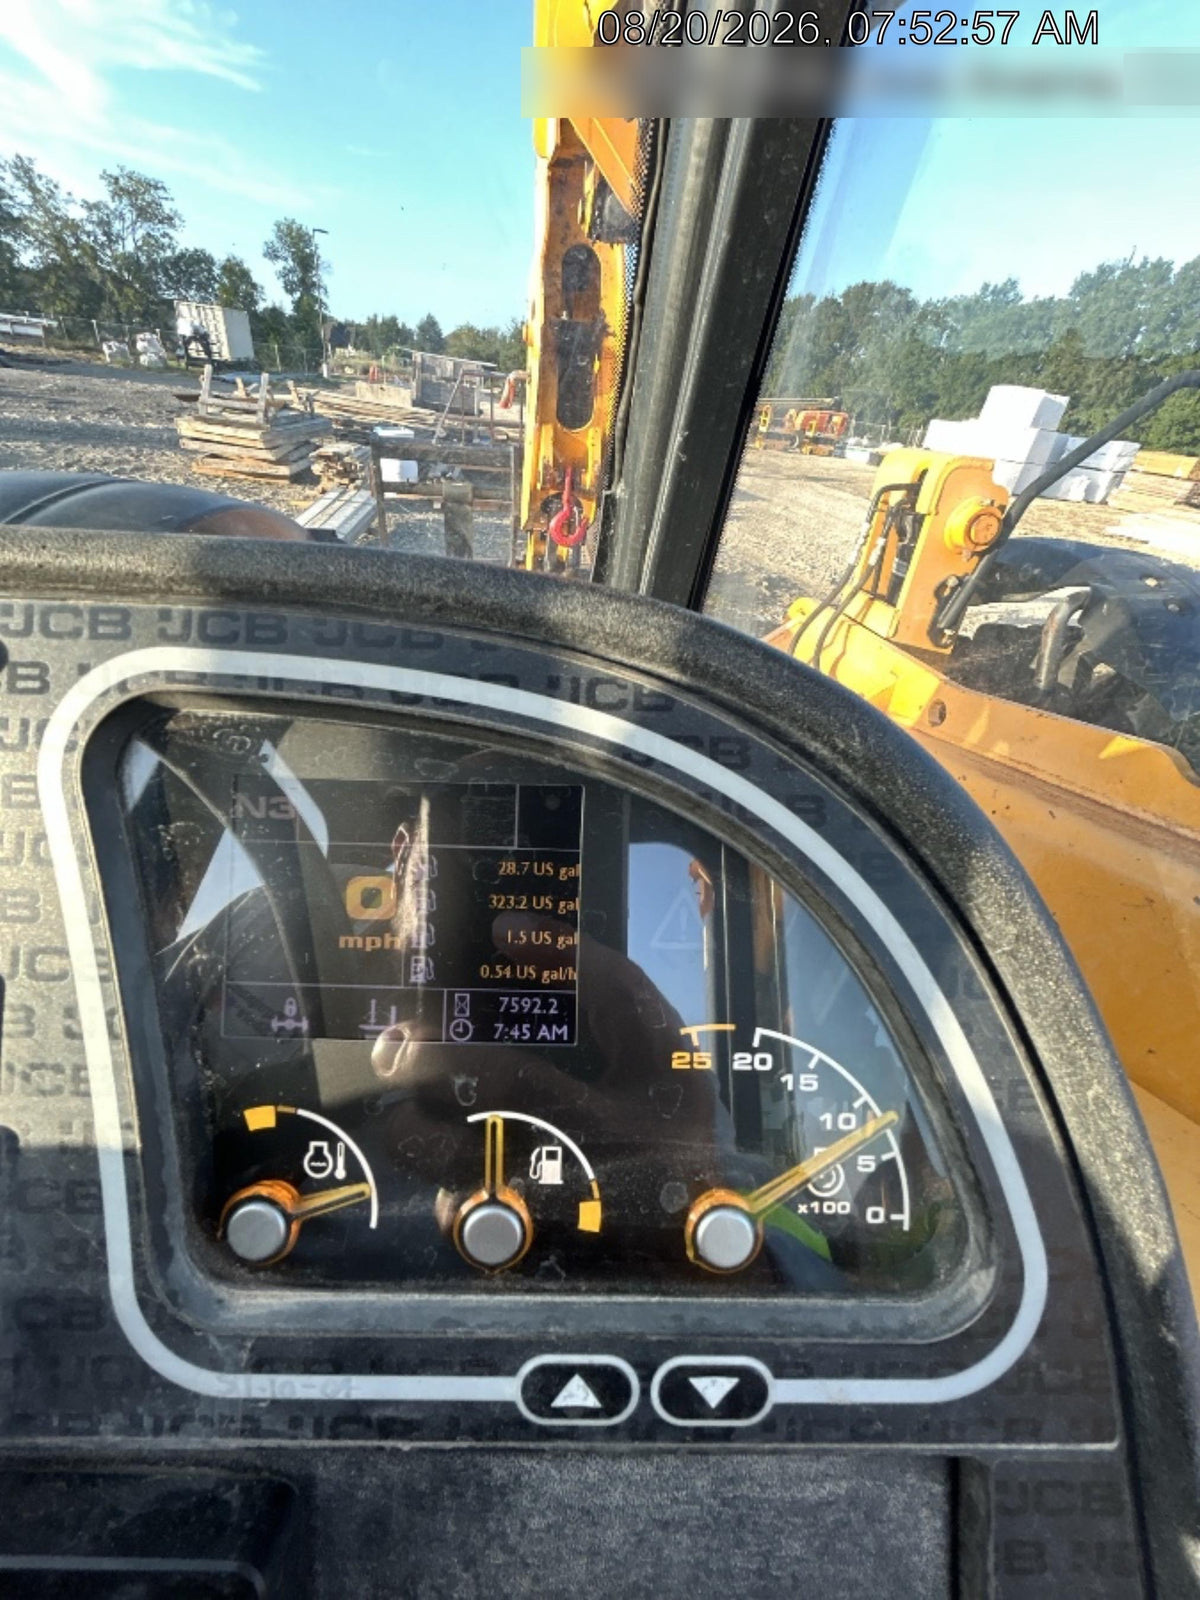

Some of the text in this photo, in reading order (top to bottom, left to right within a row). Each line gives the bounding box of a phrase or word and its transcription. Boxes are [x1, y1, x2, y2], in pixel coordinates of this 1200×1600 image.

[0, 606, 132, 640] JCB
[157, 608, 289, 646] JCB
[230, 793, 297, 820] N3
[498, 861, 580, 882] 28.7 US gal
[345, 875, 398, 920] 0
[488, 894, 579, 915] 323.2 US gal
[338, 932, 402, 952] mph
[507, 929, 578, 951] 1.5 US gal
[480, 964, 577, 984] 0.54 US gal/h
[498, 996, 559, 1015] 7592.2
[493, 1023, 569, 1041] 7:45 AM
[671, 1051, 713, 1070] 25
[732, 1051, 774, 1071] 20
[780, 1072, 819, 1092] 15
[818, 1112, 857, 1131] 10
[856, 1154, 877, 1173] 5
[796, 1200, 851, 1215] x100
[866, 1206, 886, 1225] 0
